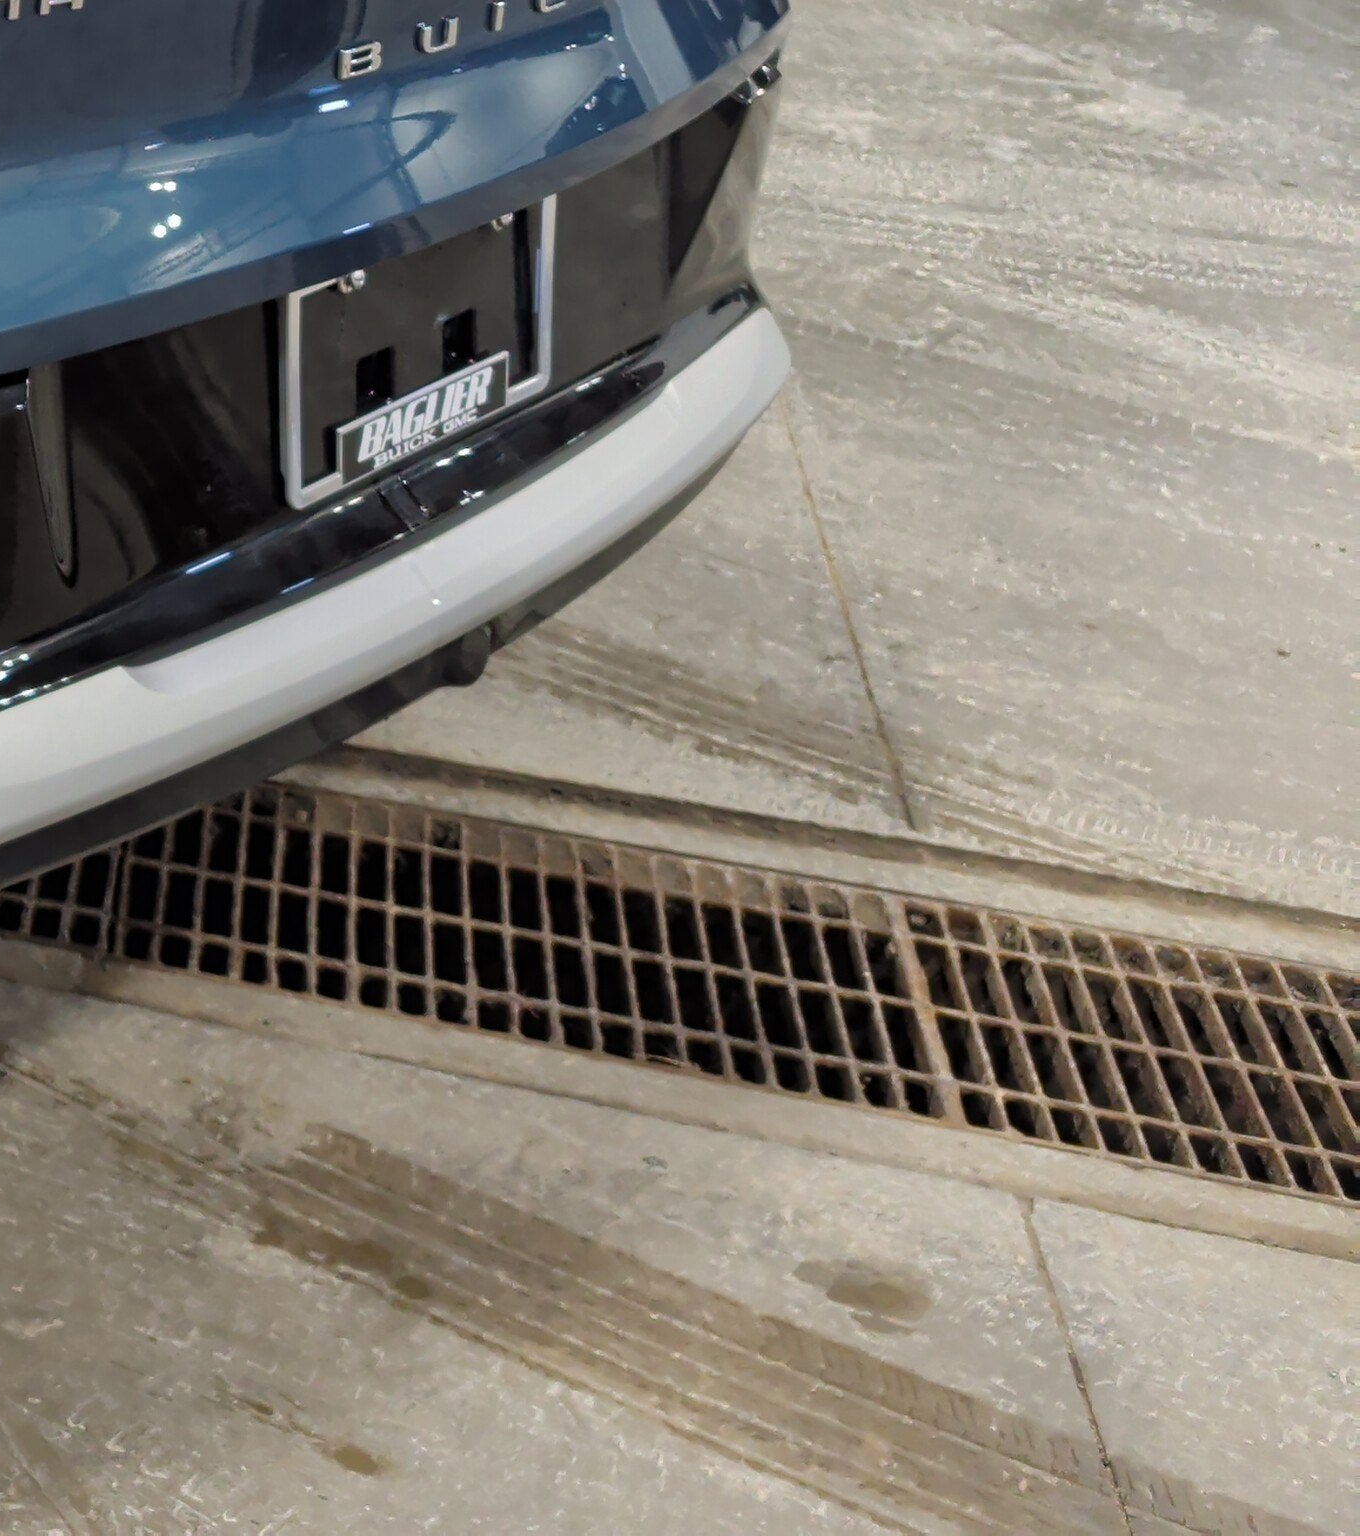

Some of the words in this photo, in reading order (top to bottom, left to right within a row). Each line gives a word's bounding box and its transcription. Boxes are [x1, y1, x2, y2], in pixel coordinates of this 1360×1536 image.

[357, 365, 494, 463] BAGLIER
[373, 427, 437, 471] BUICK
[442, 409, 478, 434] GMC
